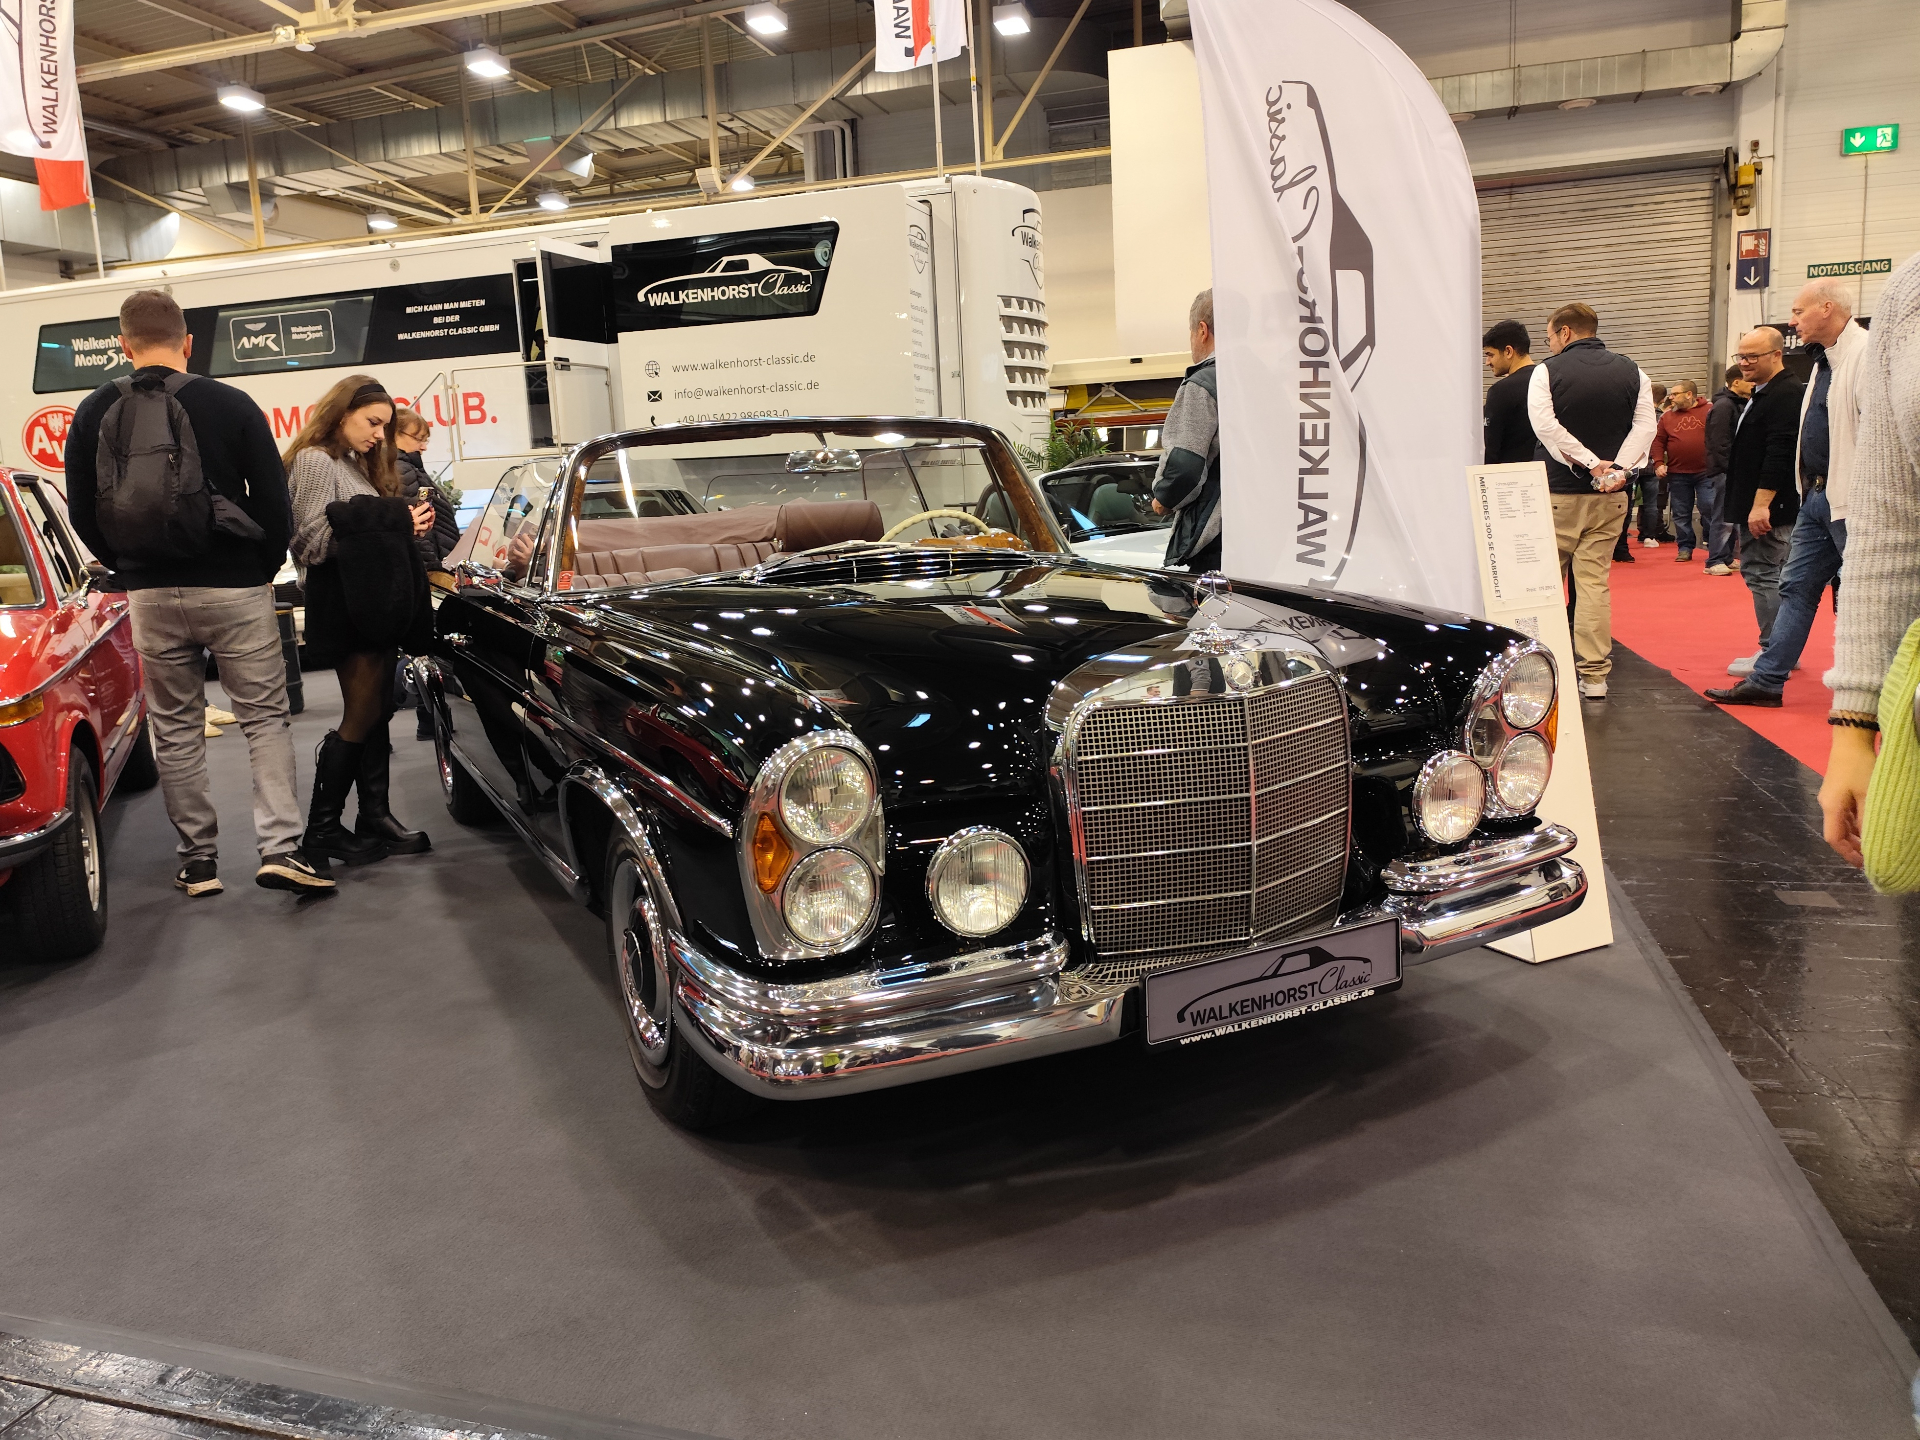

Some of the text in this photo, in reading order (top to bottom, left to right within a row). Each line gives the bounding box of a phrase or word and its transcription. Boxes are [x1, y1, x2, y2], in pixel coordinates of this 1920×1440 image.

[1809, 260, 1890, 277] NOTAUSGANG
[647, 273, 811, 307] WALKENHORST Classic
[406, 299, 486, 314] MICH KANN MAN MIETEN
[433, 314, 460, 324] BEI DER
[398, 323, 500, 340] WALKENHORST CLASSIC GMBH
[71, 335, 122, 351] Walkenh
[74, 349, 132, 371] MotorSp
[671, 352, 817, 373] www.walkenhorst-classic.de
[673, 380, 820, 400] info@walkenhorst-classic.de
[1479, 476, 1502, 599] MERCEDES 300 SE CABRIOLET
[1190, 965, 1371, 1027] WALKENHORST Classic
[1180, 988, 1375, 1046] www.WALKENHORST-CLASSIC.de
